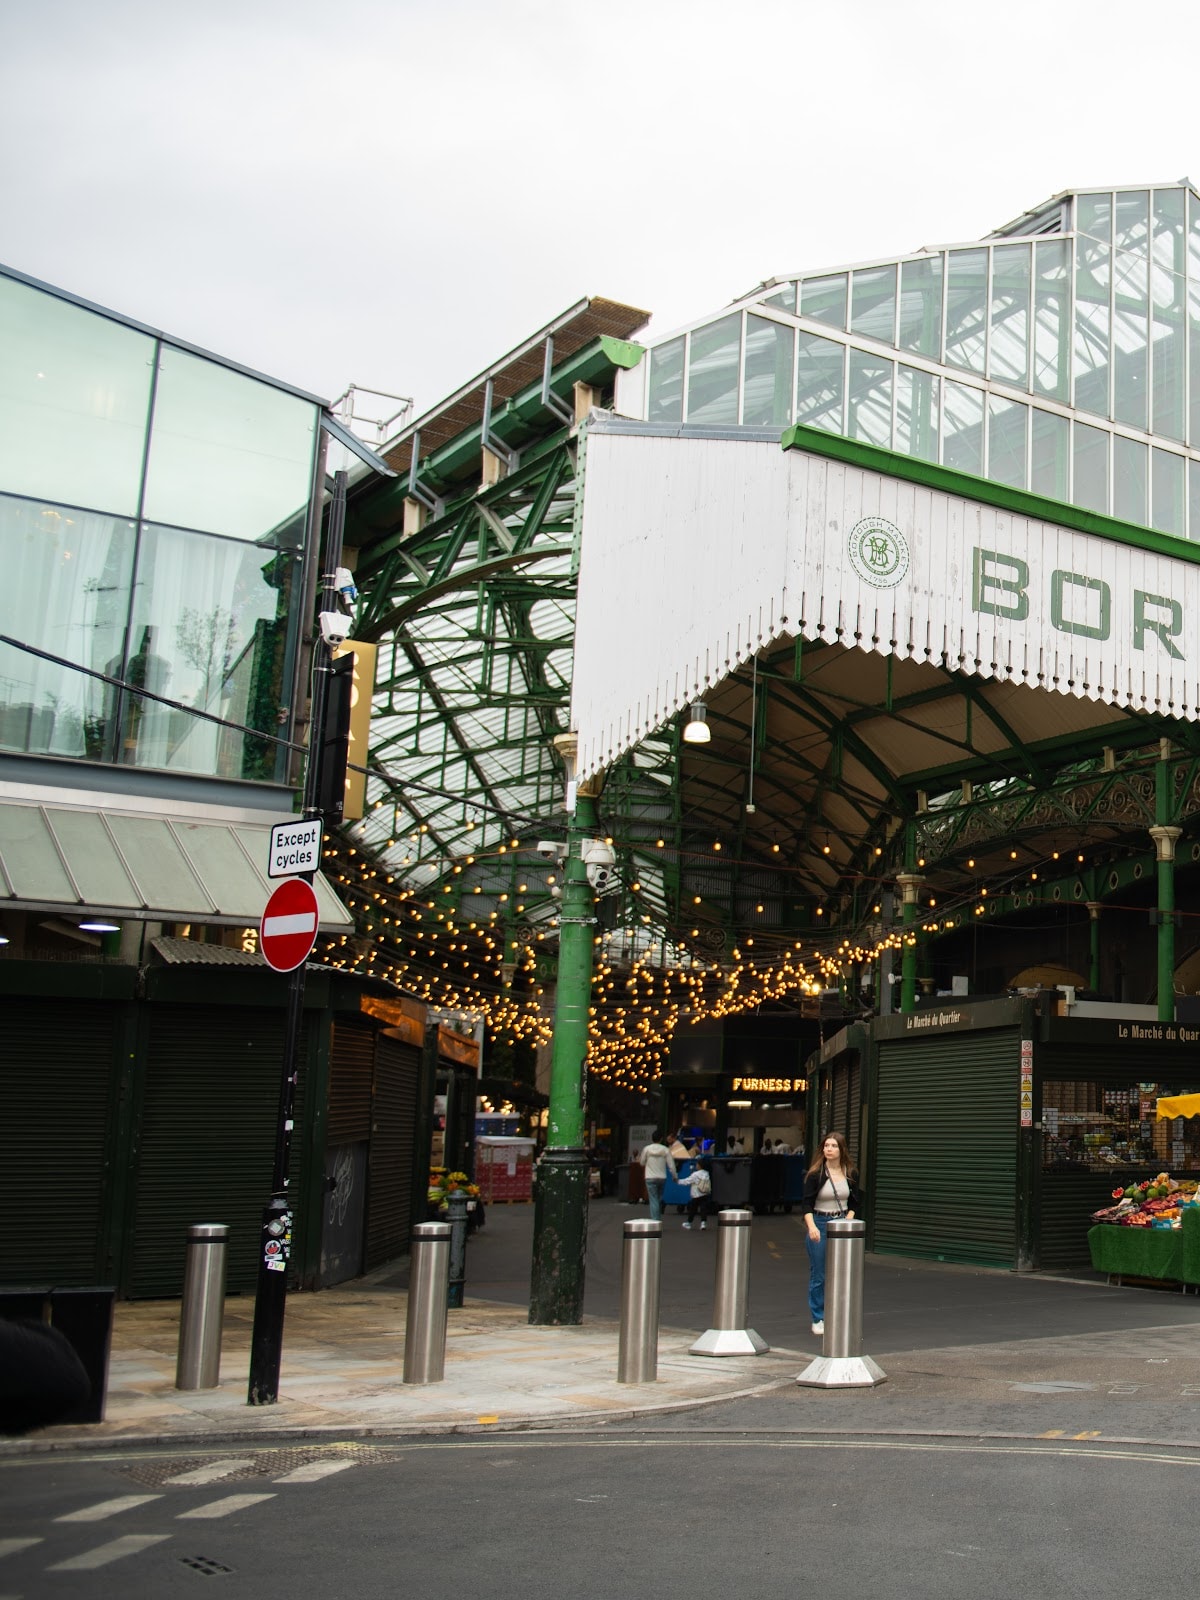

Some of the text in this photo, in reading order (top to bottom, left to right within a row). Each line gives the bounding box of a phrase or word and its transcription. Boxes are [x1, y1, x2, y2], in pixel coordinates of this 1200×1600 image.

[276, 828, 316, 848] Except
[276, 850, 312, 869] cycles
[1118, 1024, 1128, 1038] Le
[1131, 1025, 1163, 1040] Marché
[1165, 1027, 1177, 1040] du
[732, 1077, 808, 1092] FURNESS FI
